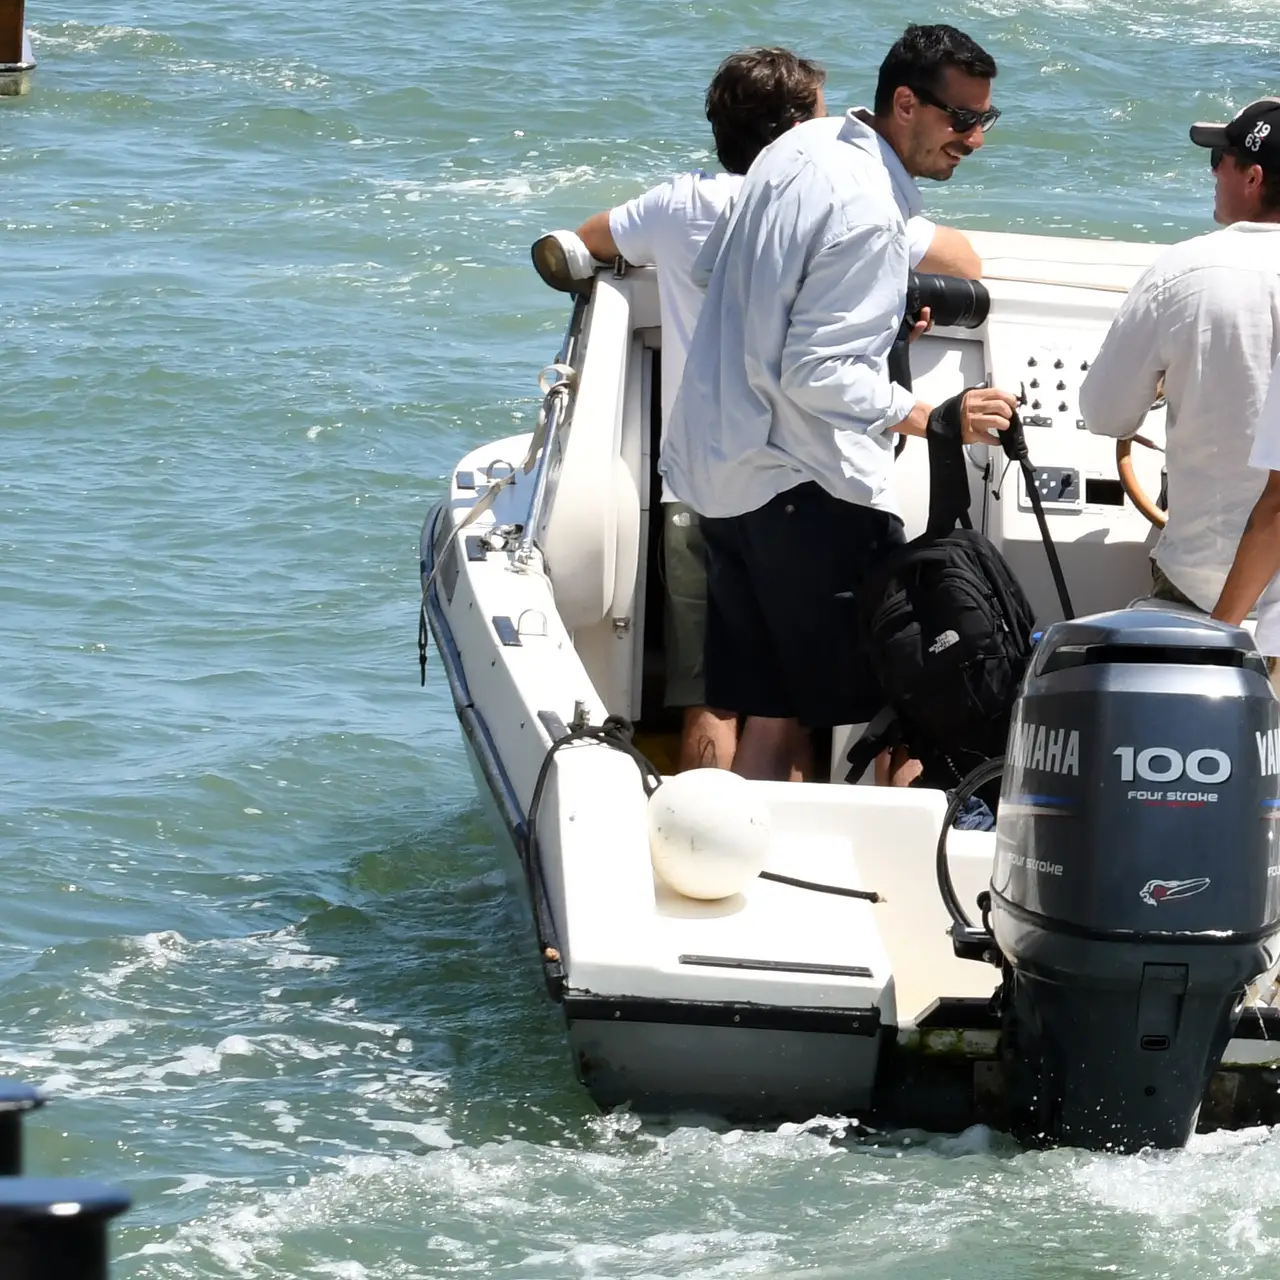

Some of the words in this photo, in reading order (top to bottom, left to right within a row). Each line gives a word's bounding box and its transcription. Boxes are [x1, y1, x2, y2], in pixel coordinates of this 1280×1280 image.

[1253, 120, 1271, 138] 19
[1245, 133, 1262, 152] 63
[1112, 746, 1232, 784] 100
